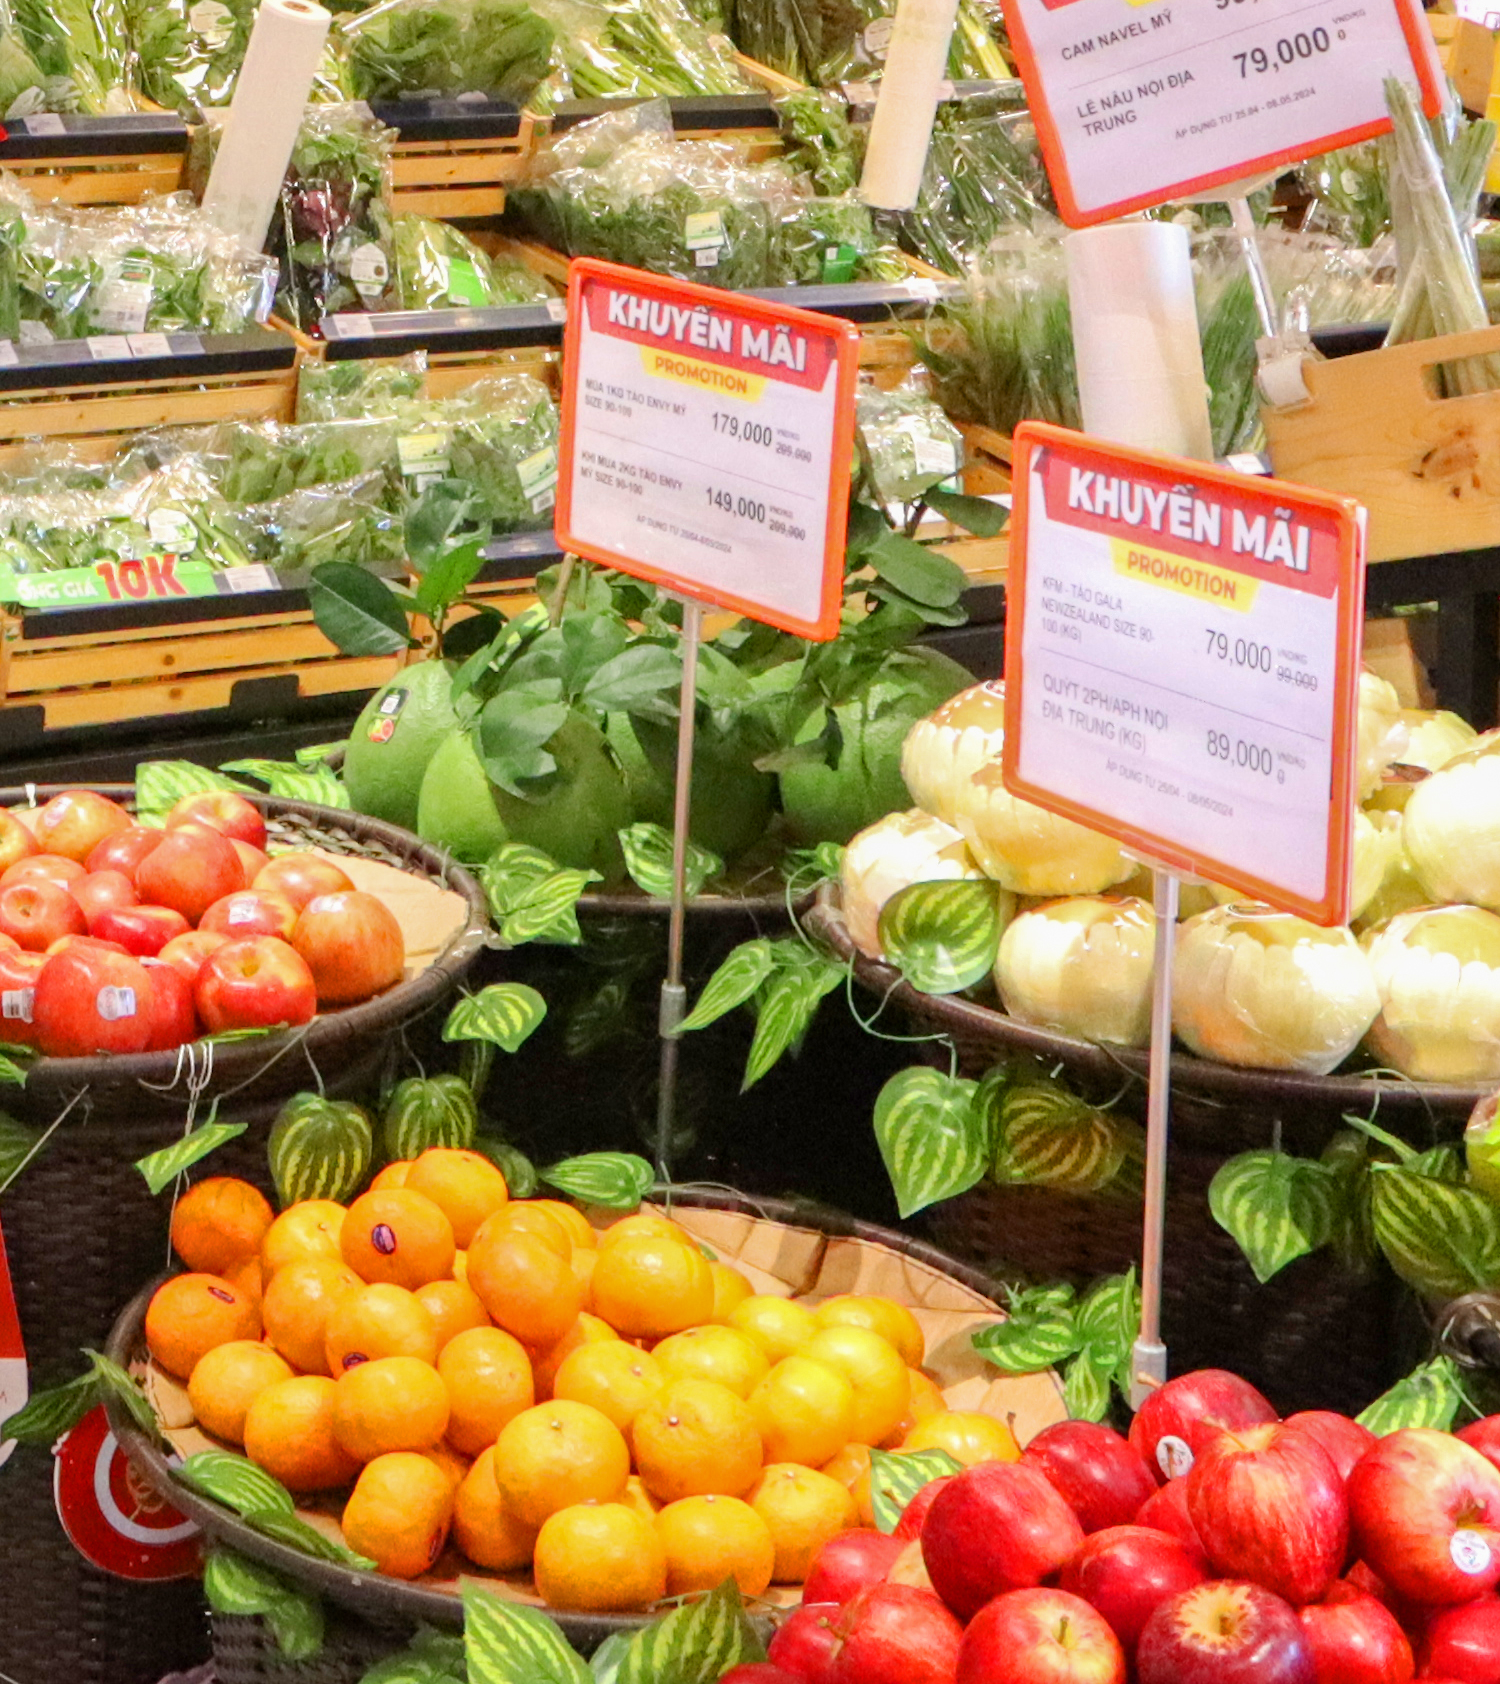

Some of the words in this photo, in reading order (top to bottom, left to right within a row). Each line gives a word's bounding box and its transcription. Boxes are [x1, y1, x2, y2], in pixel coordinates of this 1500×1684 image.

[1061, 40, 1096, 62] CAM
[1098, 22, 1148, 50] NAVEL
[1150, 8, 1174, 33] MỸ
[1233, 27, 1331, 80] 79,000
[1077, 97, 1098, 120] LÊ
[1101, 87, 1135, 114] NÂU
[1082, 109, 1138, 138] TRUNG
[608, 290, 733, 354] KHUYẾN
[741, 324, 808, 373] MÃI
[655, 355, 749, 395] PROMOTION
[711, 412, 773, 448] 179,000
[705, 486, 767, 524] 149,000
[1068, 467, 1221, 548] KHUYẾN
[1231, 506, 1312, 573] MÃI
[96, 553, 189, 601] 10K
[1127, 550, 1237, 602] PROMOTION
[1041, 597, 1111, 632] NEWZEALAND
[1113, 615, 1138, 639] SIZE
[1095, 590, 1123, 612] GALA
[1205, 628, 1272, 674] 79,000
[1043, 673, 1079, 701] QUÝT
[1068, 707, 1116, 741] TRUNG
[1207, 728, 1274, 777] 89,000
